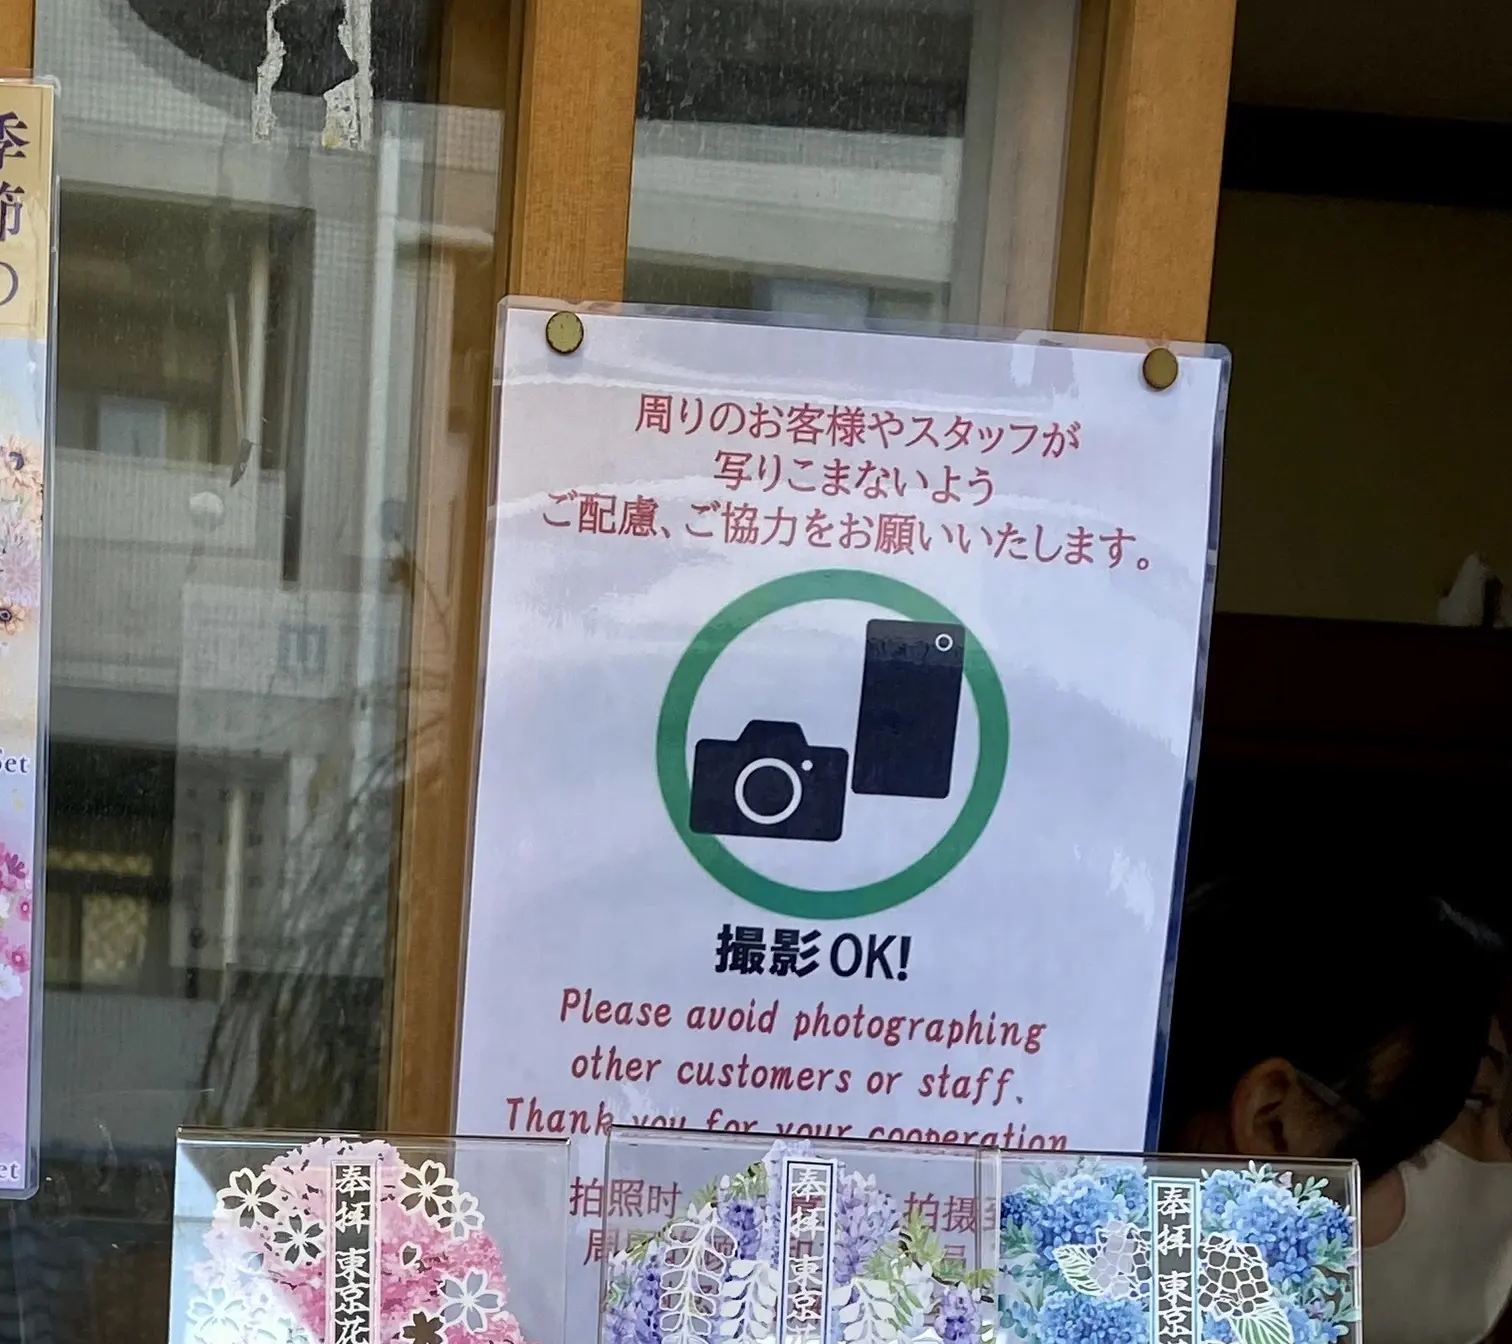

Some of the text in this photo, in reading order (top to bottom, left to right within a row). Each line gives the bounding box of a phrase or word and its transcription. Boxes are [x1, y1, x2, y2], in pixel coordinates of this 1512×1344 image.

[635, 393, 1080, 459] 周りのお客様やスタッフが
[713, 452, 995, 503] 写りこまないよう
[541, 491, 1151, 572] ご配慮、ご協力をお願いいたします。
[561, 988, 1047, 1054] Please avoid photographing
[571, 1048, 661, 1083] other
[677, 1059, 850, 1094] customers
[866, 1070, 901, 1095] or
[507, 1096, 614, 1136] Thank
[707, 1108, 759, 1134] for
[335, 1163, 371, 1235] 奉拝
[791, 1166, 829, 1240] 奉拝
[1158, 1185, 1194, 1255] 奉拝
